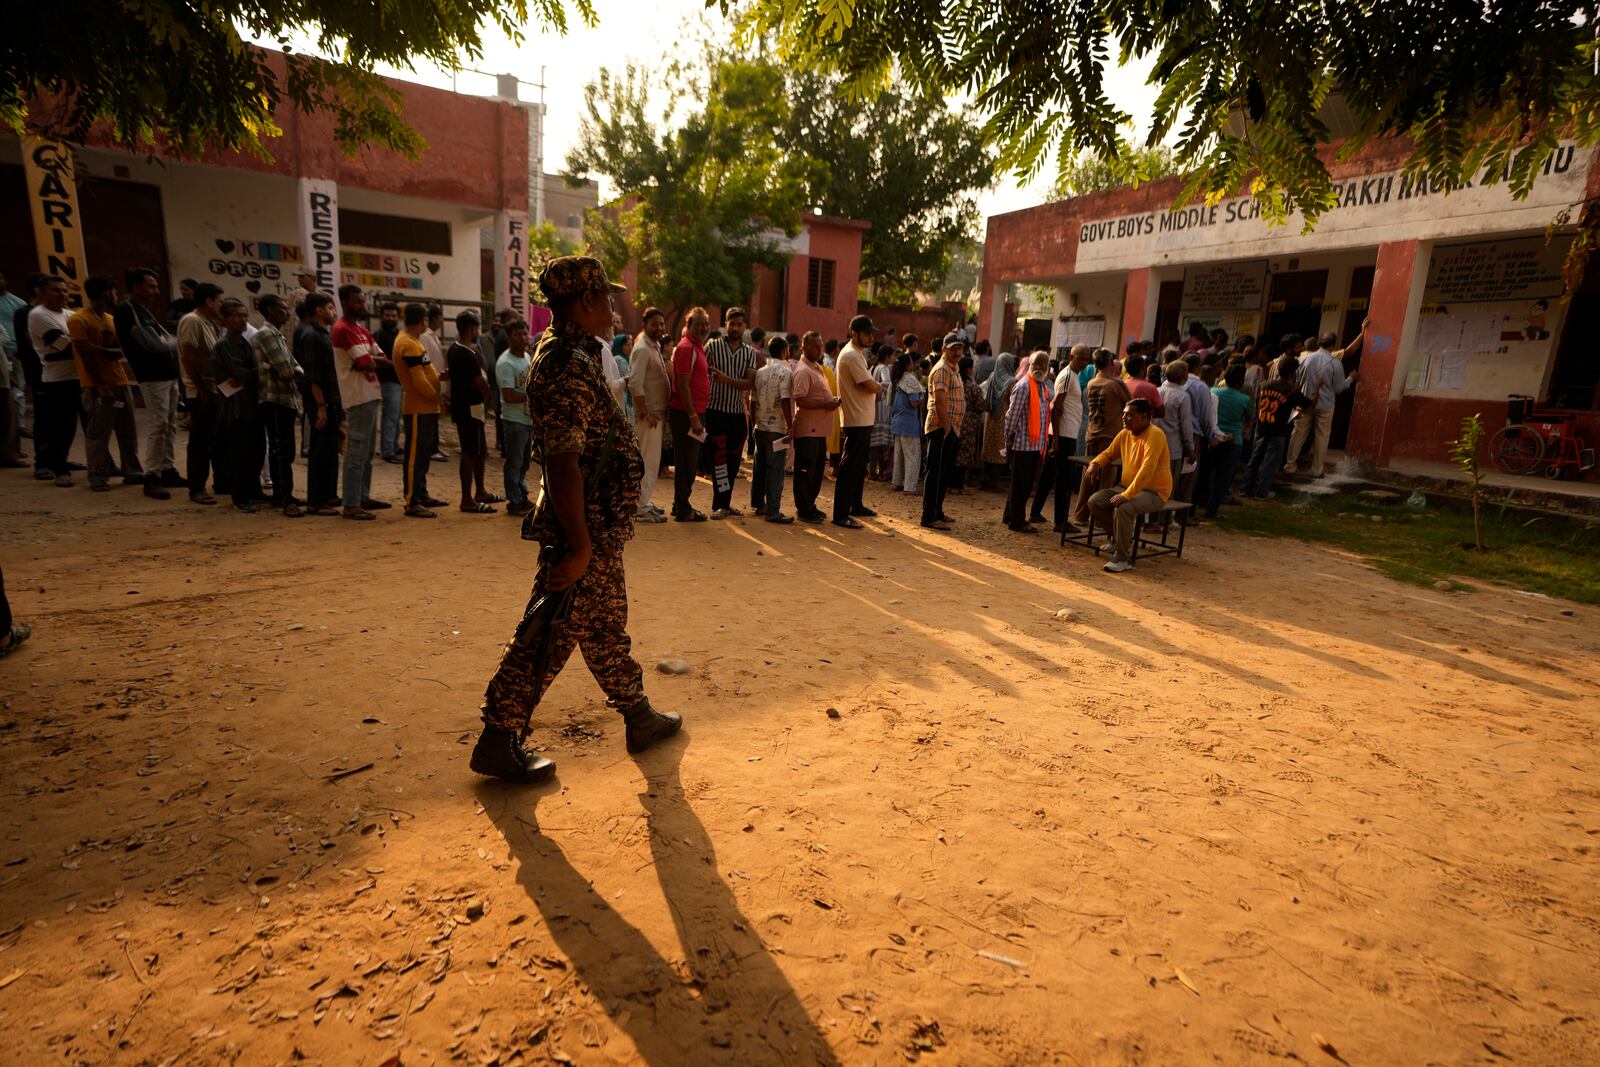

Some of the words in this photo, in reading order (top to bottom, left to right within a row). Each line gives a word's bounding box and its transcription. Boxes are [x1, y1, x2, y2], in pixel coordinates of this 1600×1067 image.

[1159, 205, 1220, 233] MIDDLE
[310, 192, 335, 295] RESPE
[209, 260, 280, 280] FREE
[404, 258, 421, 274] IS
